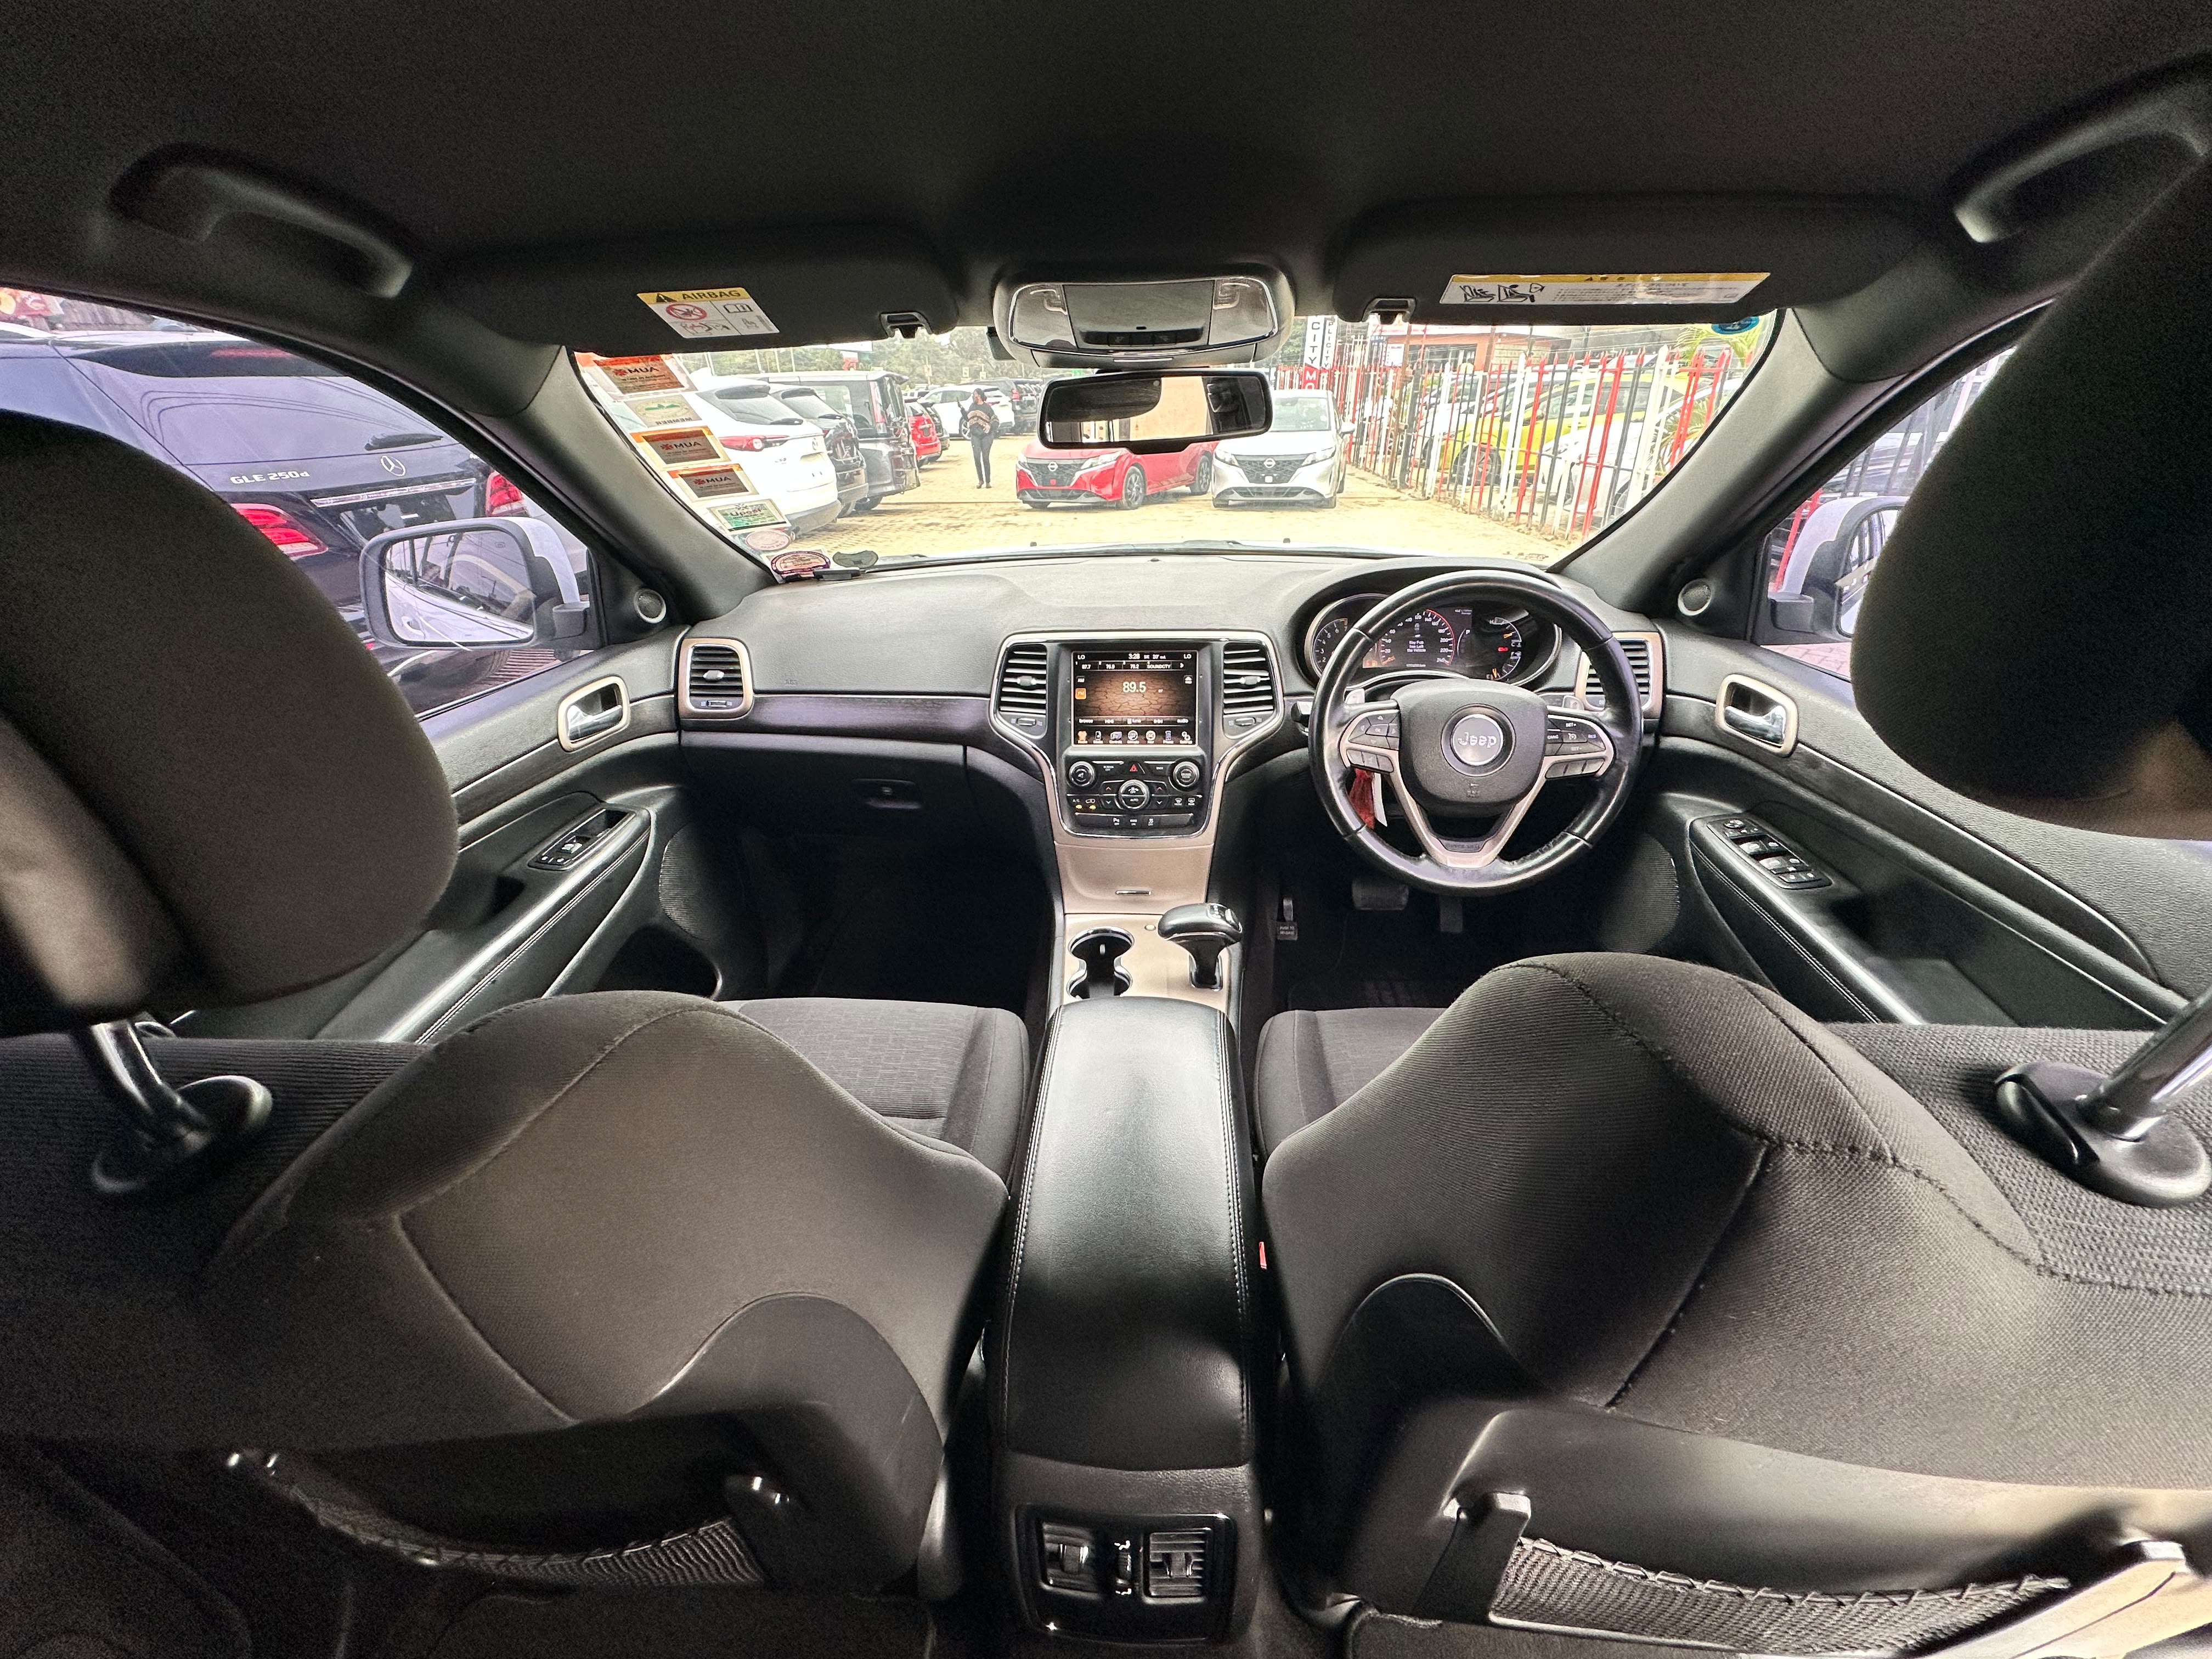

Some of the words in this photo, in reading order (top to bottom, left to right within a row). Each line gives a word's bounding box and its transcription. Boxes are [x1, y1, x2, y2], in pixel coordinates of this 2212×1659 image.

[682, 290, 741, 300] AIRBAG
[1308, 315, 1321, 364] CITY
[230, 475, 266, 484] GLE
[267, 471, 310, 480] 250d
[1122, 681, 1147, 693] 89.5
[1457, 732, 1498, 749] Jeep
